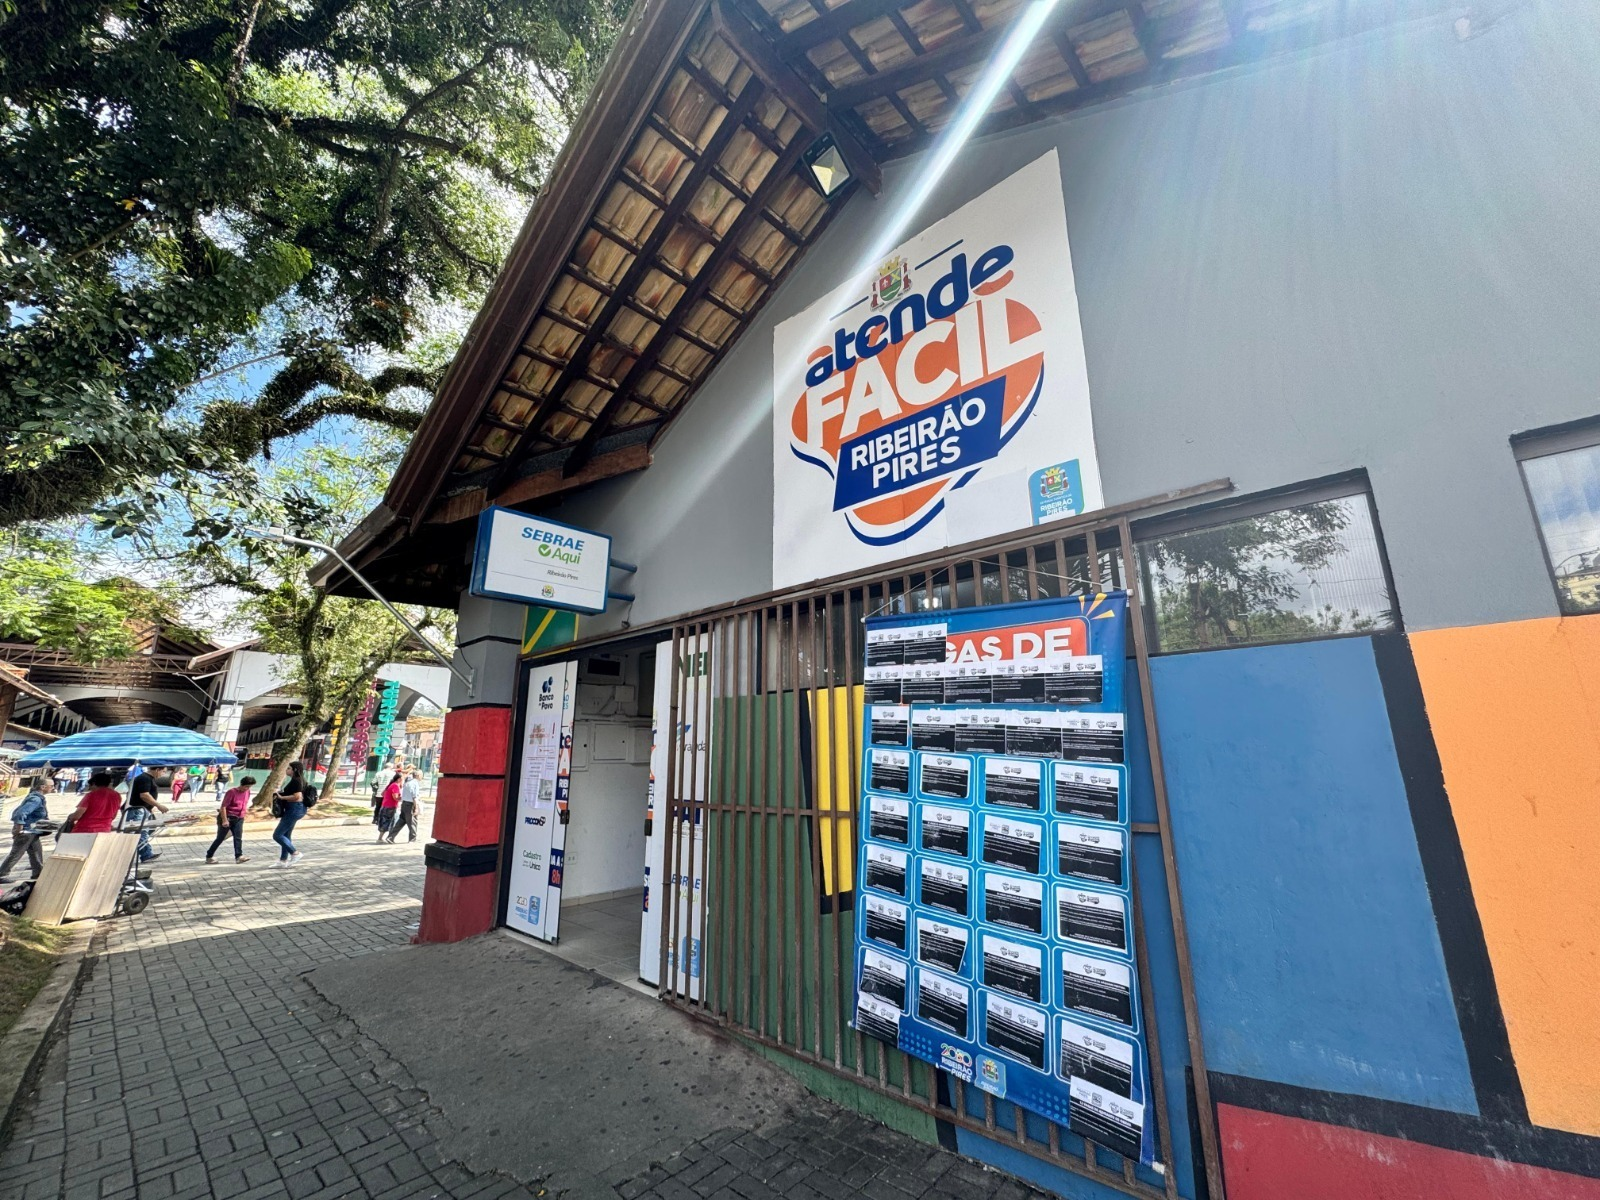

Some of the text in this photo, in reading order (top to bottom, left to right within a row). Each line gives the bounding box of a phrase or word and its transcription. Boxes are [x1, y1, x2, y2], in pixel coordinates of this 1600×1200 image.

[805, 244, 1014, 388] atende
[852, 397, 986, 470] RIBEIRÃO
[872, 436, 961, 489] PIRES
[522, 527, 584, 551] SEBRAE
[551, 547, 582, 564] Aqui
[946, 637, 1003, 663] GAS
[1012, 627, 1073, 662] DE
[539, 693, 554, 702] Banco
[541, 702, 554, 710] Povo
[373, 680, 401, 756] TURÍSTICO
[522, 849, 542, 861] Cadastro
